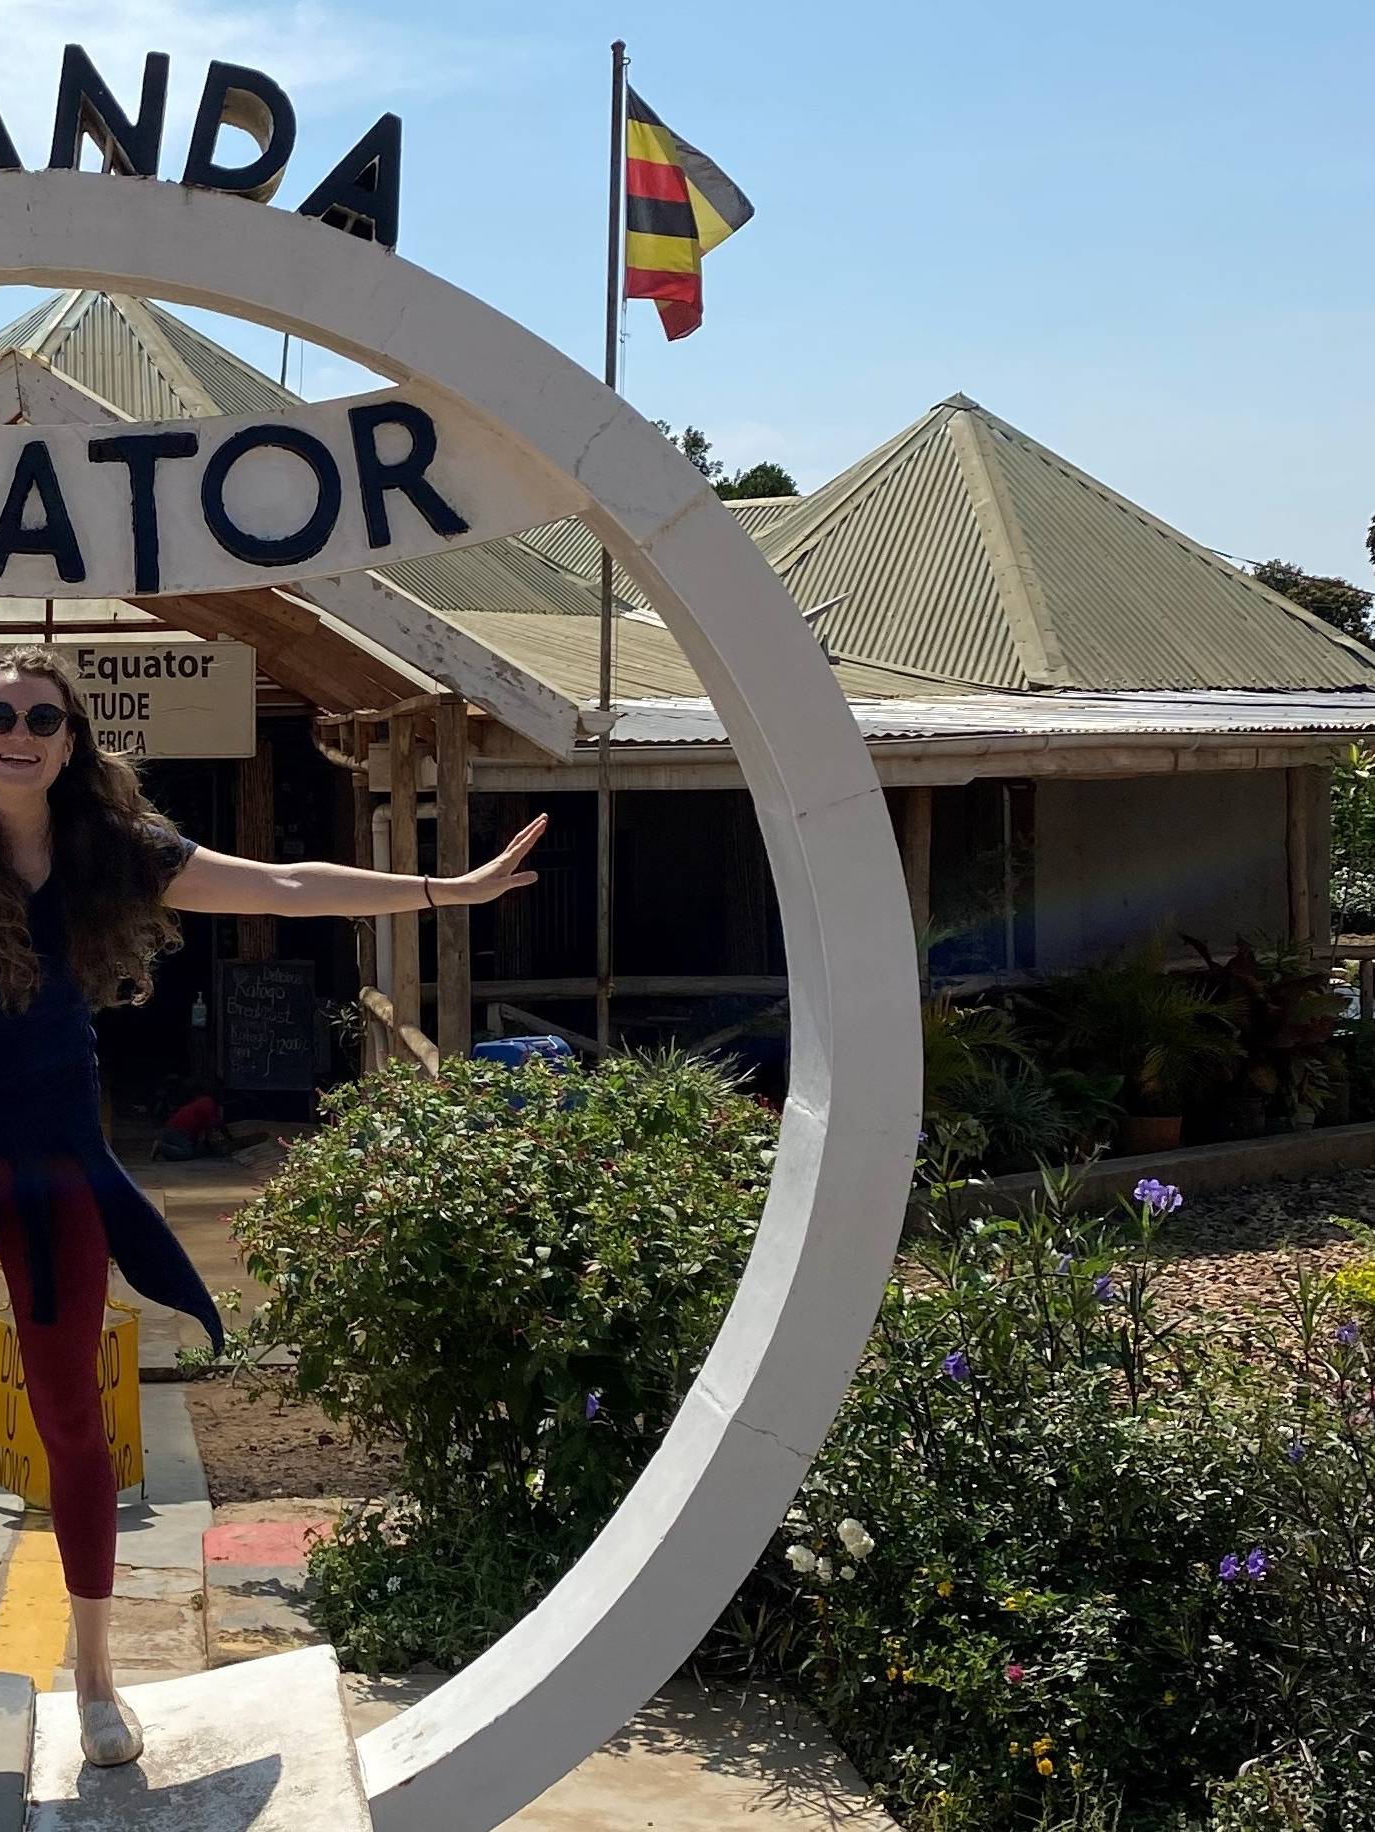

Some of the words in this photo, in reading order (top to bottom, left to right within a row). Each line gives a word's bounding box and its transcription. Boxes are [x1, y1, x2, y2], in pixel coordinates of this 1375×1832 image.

[77, 648, 214, 686] Equator
[97, 729, 147, 756] FRICA
[6, 1391, 17, 1441] U
[105, 1394, 116, 1445] U
